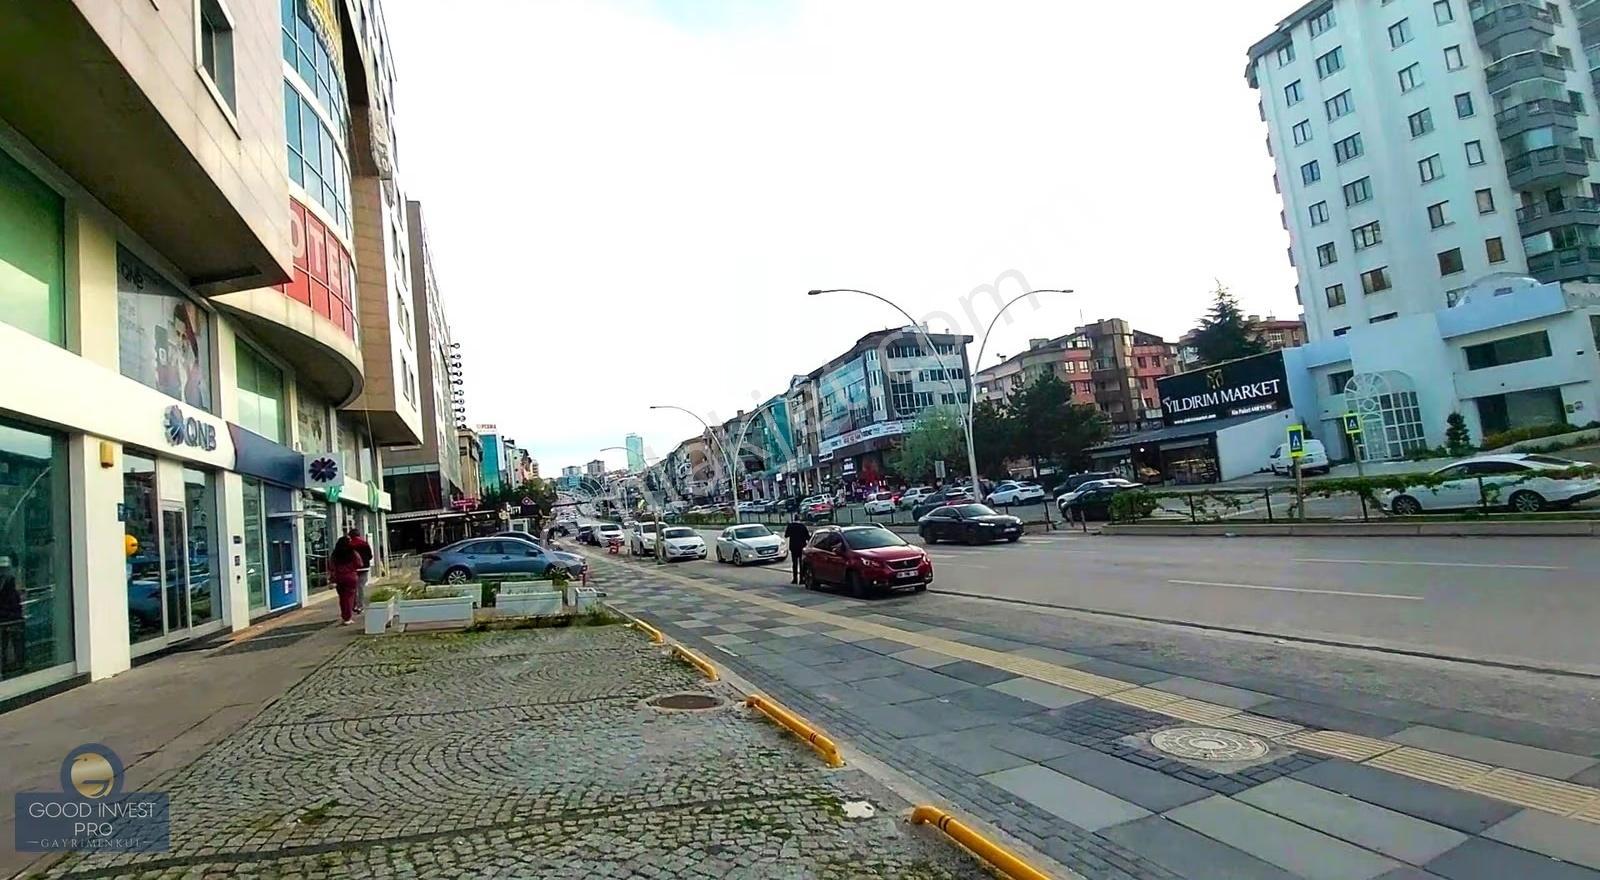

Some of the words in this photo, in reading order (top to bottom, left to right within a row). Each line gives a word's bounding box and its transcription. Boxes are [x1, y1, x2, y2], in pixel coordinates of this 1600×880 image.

[1164, 392, 1220, 413] YILDIRIM
[1220, 379, 1280, 403] MARKET
[184, 421, 217, 452] QNB
